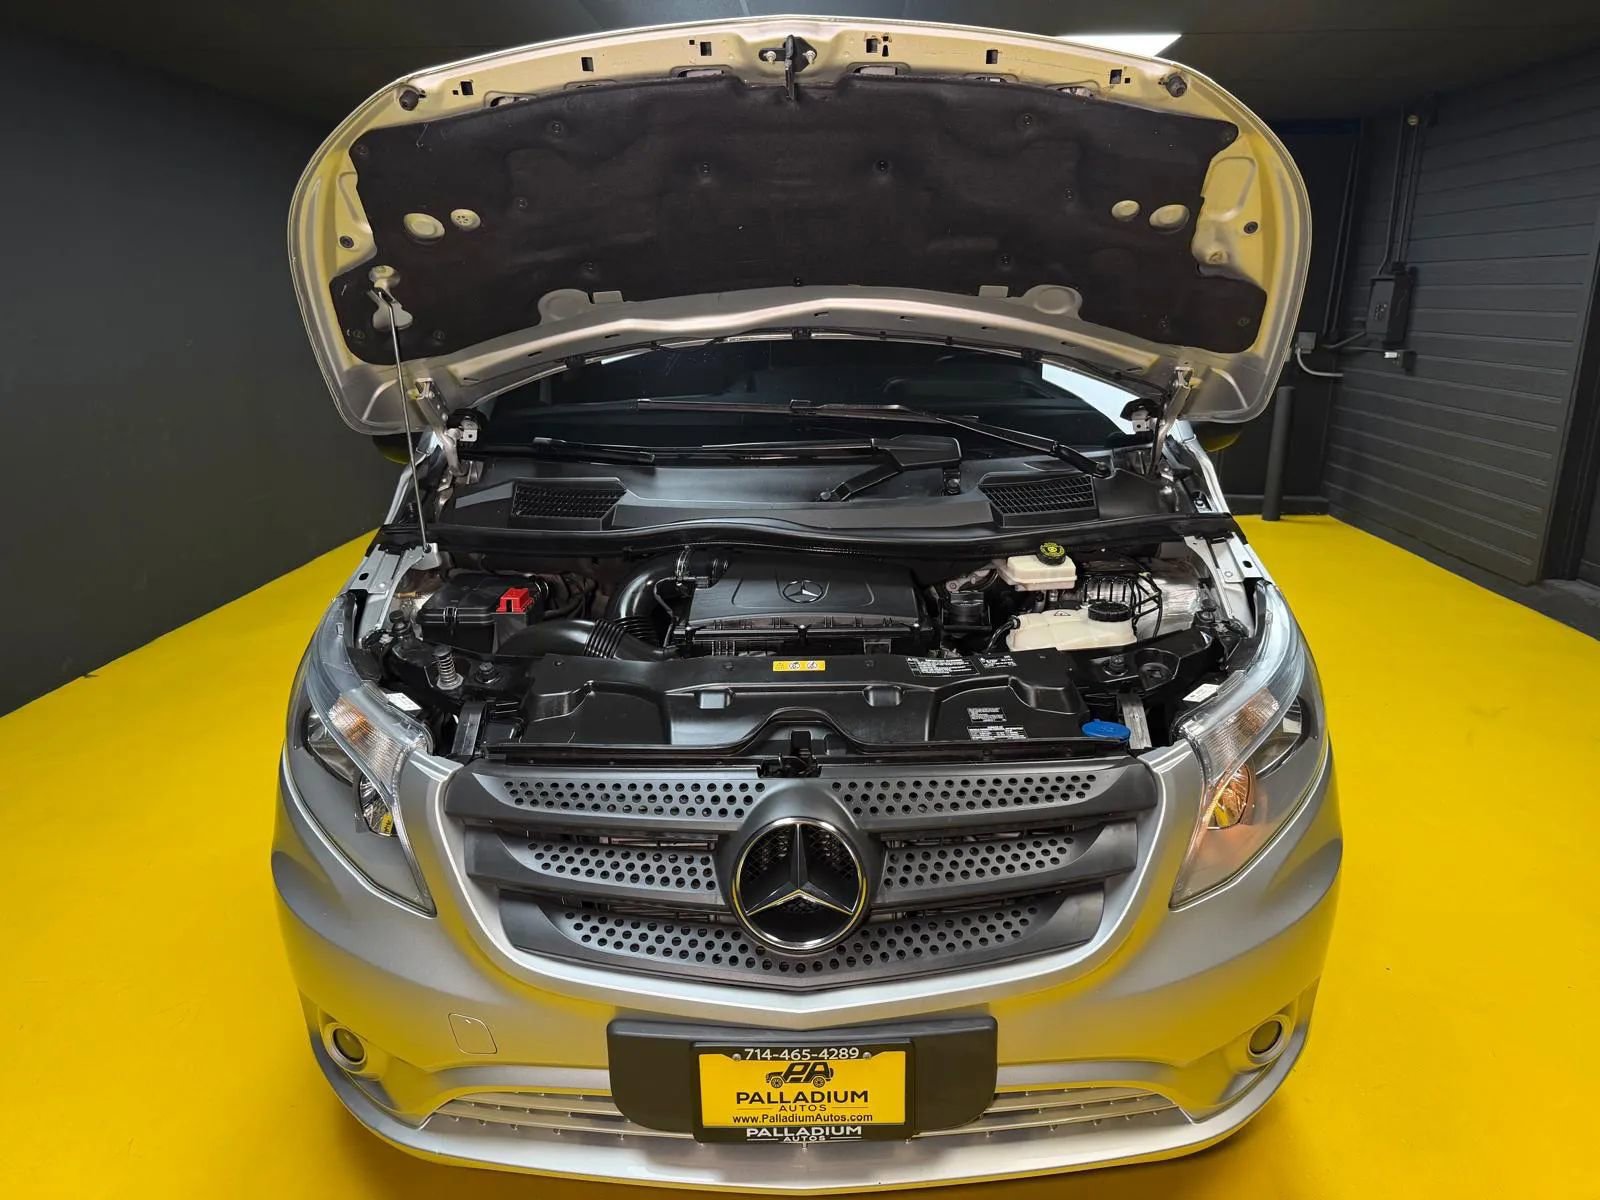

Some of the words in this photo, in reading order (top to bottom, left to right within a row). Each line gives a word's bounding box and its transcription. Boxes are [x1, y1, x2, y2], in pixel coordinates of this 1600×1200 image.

[744, 1047, 859, 1061] 714-465-4289
[736, 1090, 869, 1105] PALLADIUM
[779, 1104, 827, 1112] AUTOS
[732, 1113, 873, 1124] www.PalladiumAutos.com
[746, 1125, 862, 1137] PALLADIUM
